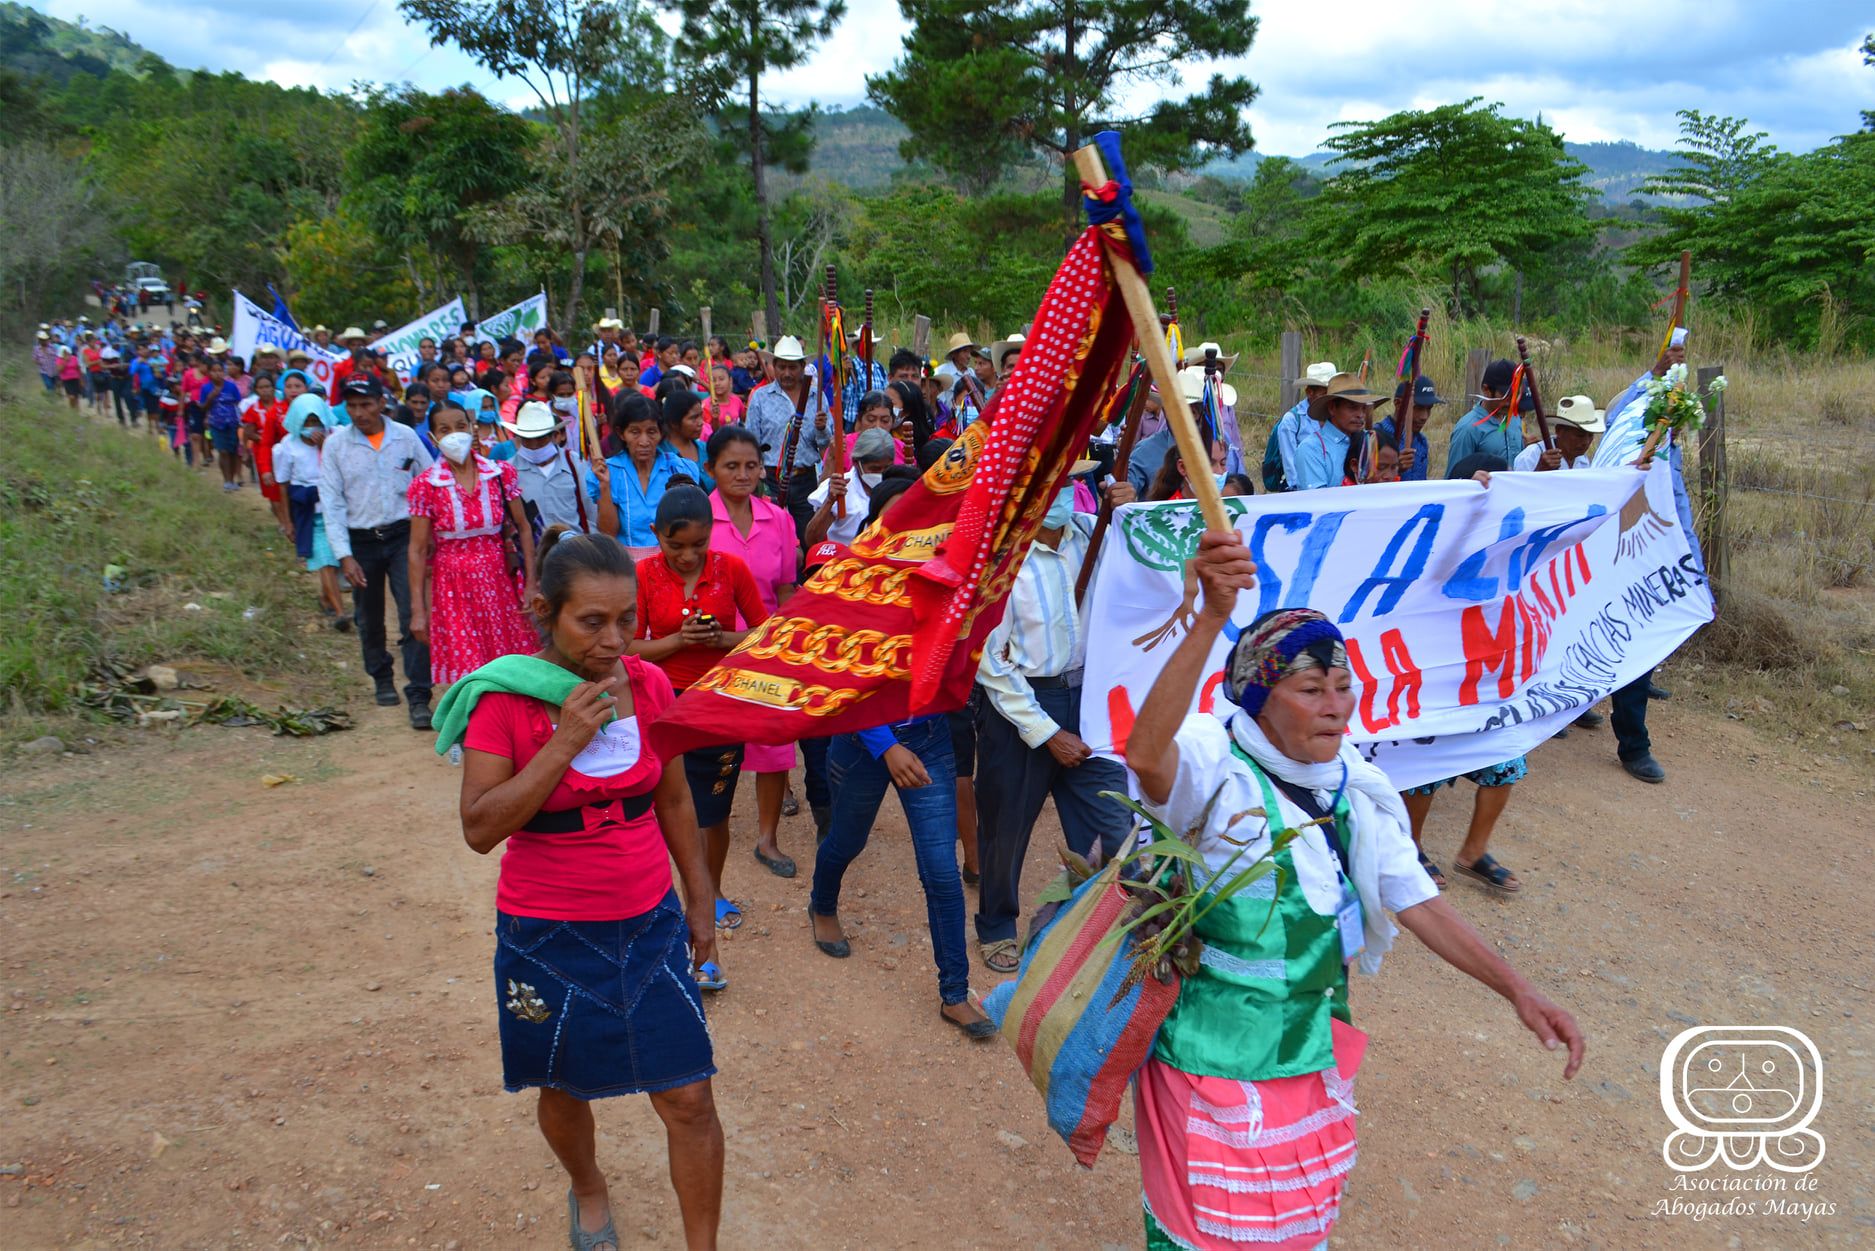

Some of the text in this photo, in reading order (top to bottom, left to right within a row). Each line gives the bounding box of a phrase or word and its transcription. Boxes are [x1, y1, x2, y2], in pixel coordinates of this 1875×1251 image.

[1337, 503, 1445, 624] A
[1622, 553, 1708, 629] MINERAS
[733, 676, 783, 697] CHANEL
[1344, 628, 1422, 734] LA
